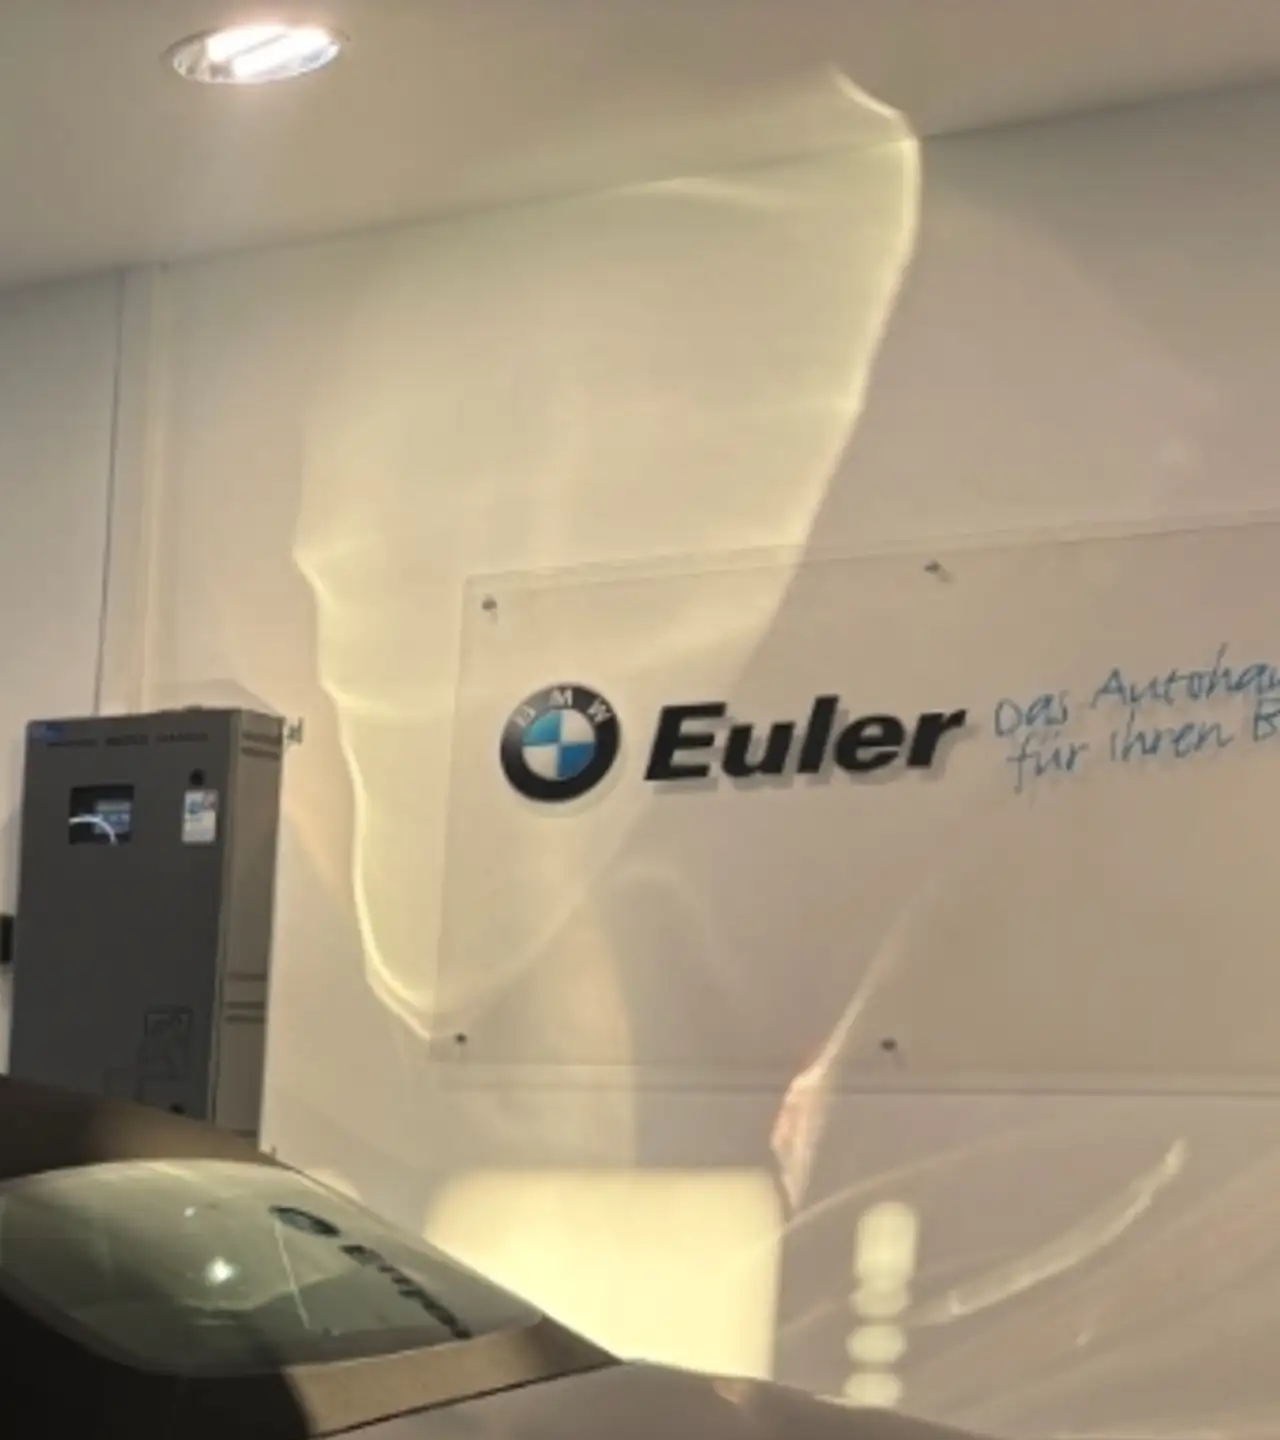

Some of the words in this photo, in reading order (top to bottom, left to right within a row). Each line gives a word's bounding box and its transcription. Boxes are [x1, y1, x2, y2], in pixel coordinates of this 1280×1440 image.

[643, 694, 968, 781] Euler
[994, 691, 1069, 738] Das
[1006, 730, 1089, 795] für
[1109, 705, 1235, 762] Ihren
